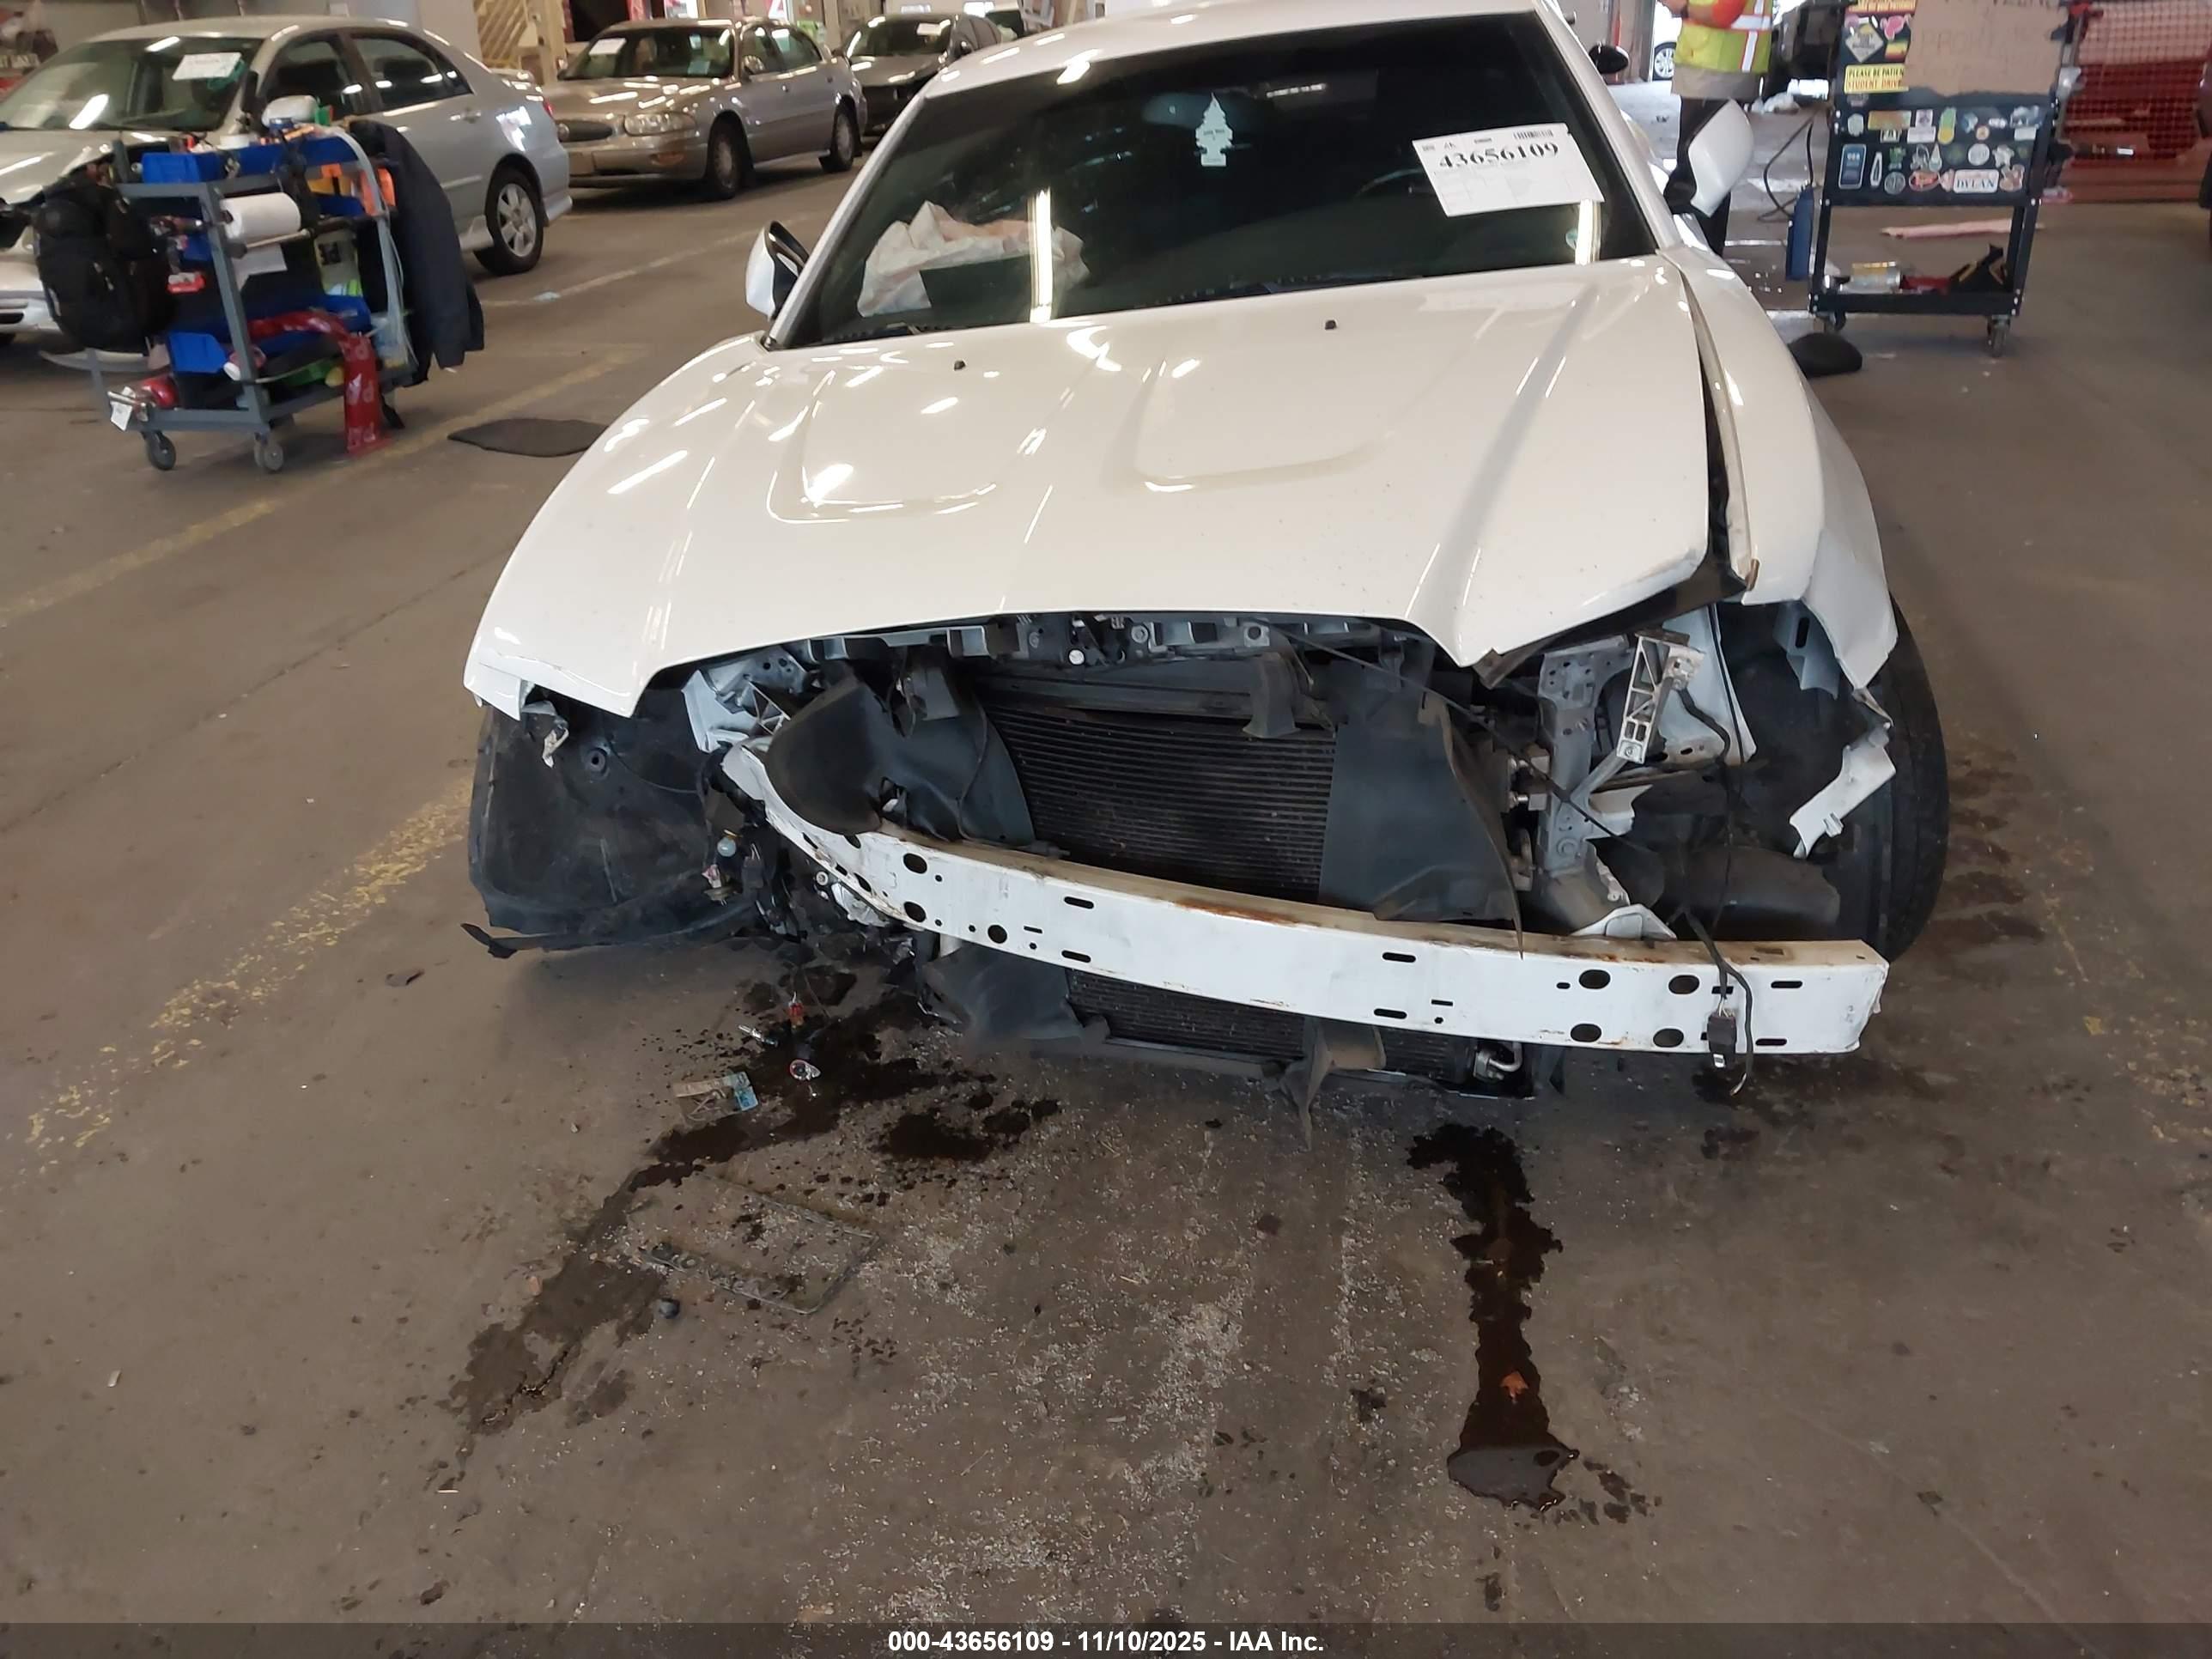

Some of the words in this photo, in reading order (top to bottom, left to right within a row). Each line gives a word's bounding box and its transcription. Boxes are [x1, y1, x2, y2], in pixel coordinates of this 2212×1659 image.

[1849, 68, 1871, 78] PLEASE
[1873, 67, 1881, 77] BE
[1882, 66, 1905, 77] PATIEN
[1848, 79, 1878, 90] STUDENT
[1881, 78, 1903, 89] DRIVE
[1439, 142, 1559, 169] 43656109
[1956, 179, 1995, 189] DYLAN
